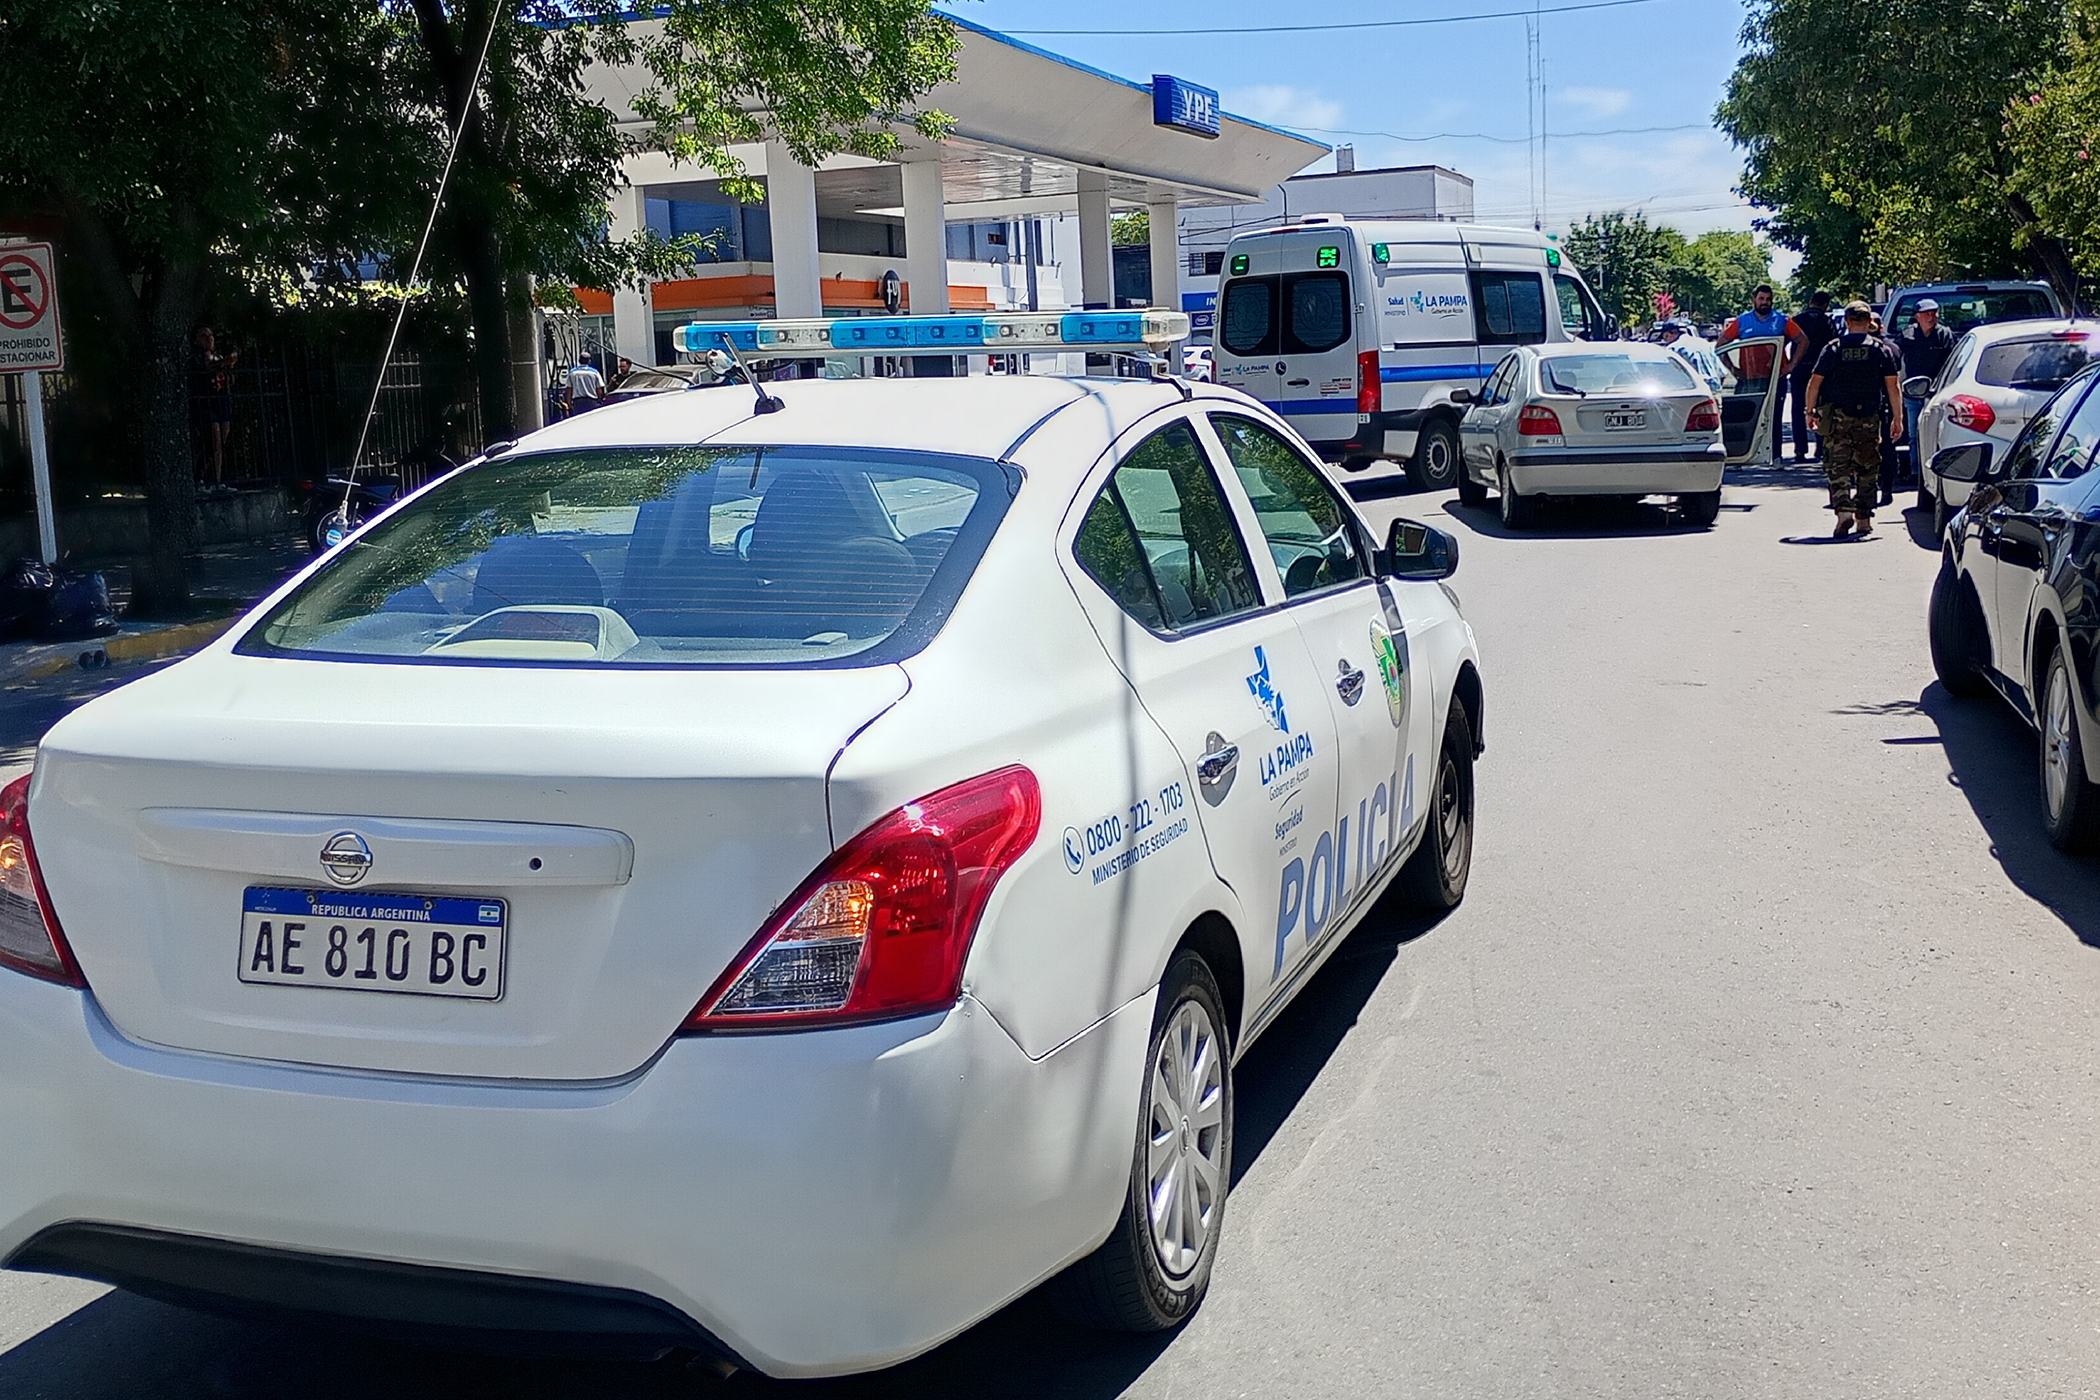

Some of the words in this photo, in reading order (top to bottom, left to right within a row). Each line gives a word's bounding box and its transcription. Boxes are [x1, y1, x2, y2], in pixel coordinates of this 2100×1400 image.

[1181, 88, 1213, 125] YPF
[1425, 296, 1438, 307] LA
[1439, 294, 1468, 306] PAMPA
[0, 351, 56, 363] STACIONAR
[1259, 751, 1277, 786] LA
[1276, 730, 1314, 776] PAMPA
[1086, 815, 1121, 856] 0800
[1130, 799, 1153, 834] 222
[1159, 781, 1183, 816] 1703
[1275, 804, 1304, 840] Seguridad
[1091, 846, 1140, 887] MINISTERIO
[1139, 839, 1151, 860] DE
[1150, 817, 1189, 853] SEGURIDAD
[1269, 752, 1415, 988] POLICIA
[311, 904, 368, 919] REPUBLICA
[370, 908, 431, 921] ARGENTINA
[250, 920, 306, 975] AE
[324, 924, 411, 982] 810
[428, 930, 487, 987] BC
